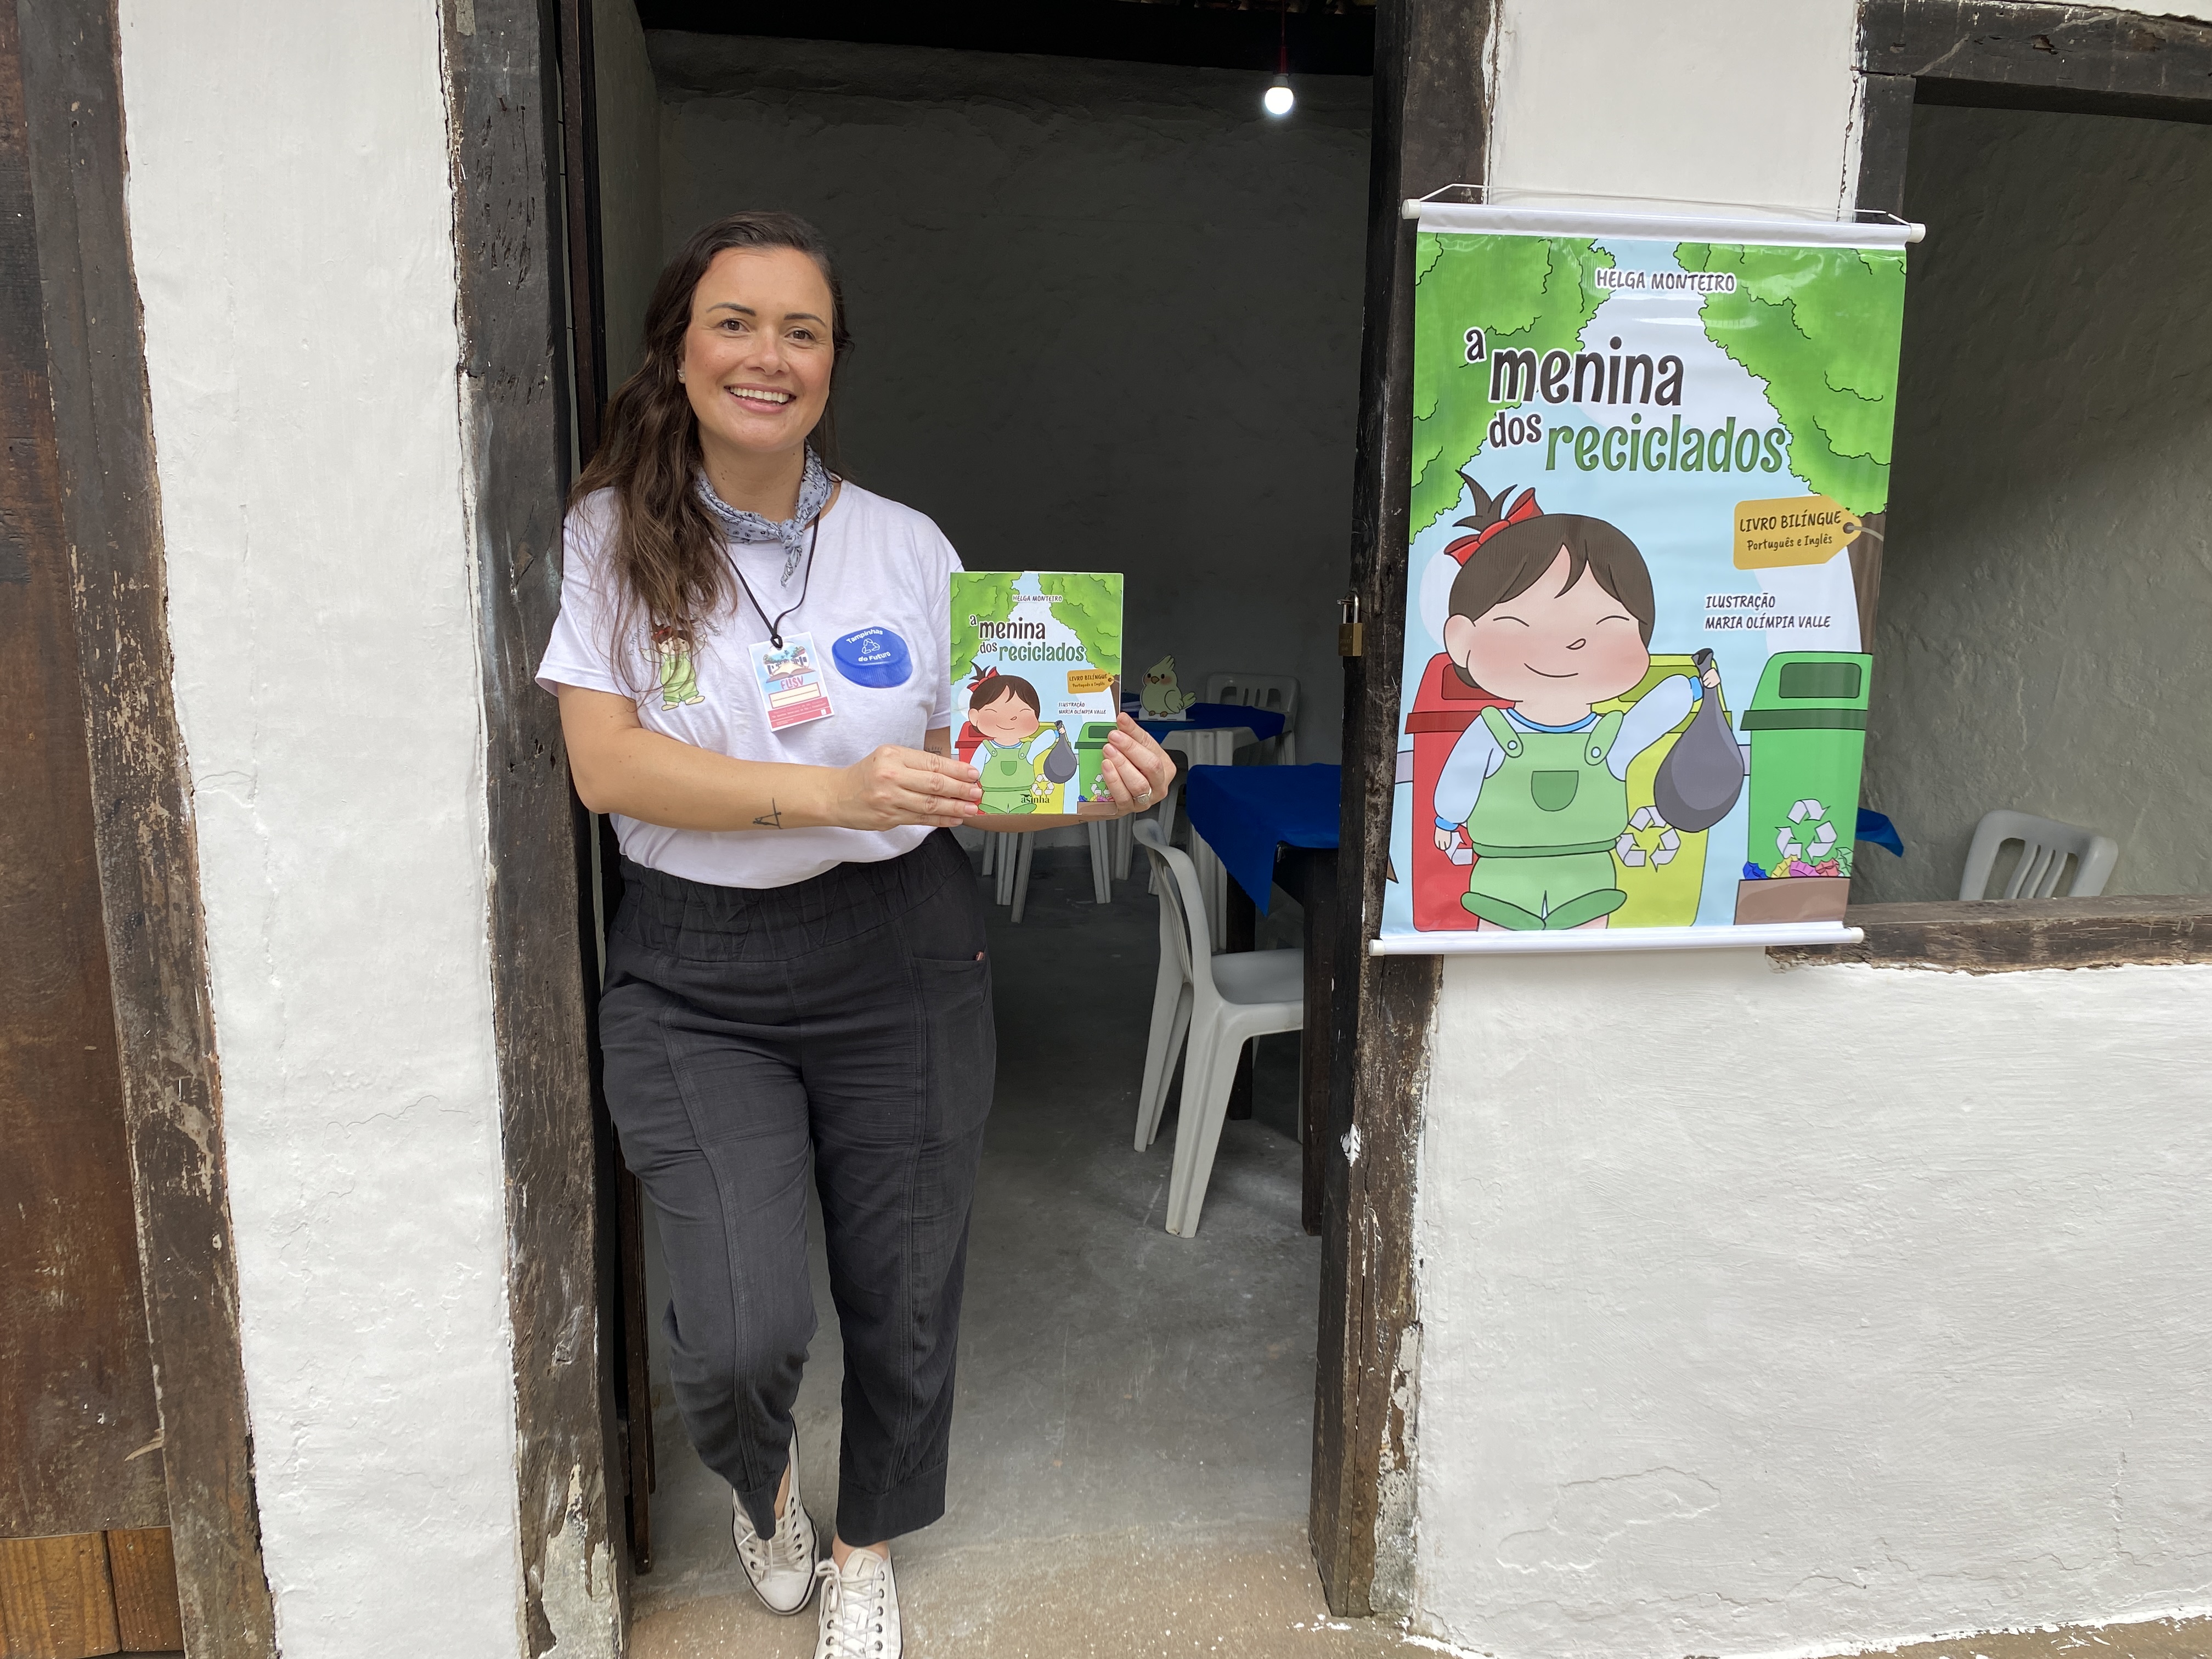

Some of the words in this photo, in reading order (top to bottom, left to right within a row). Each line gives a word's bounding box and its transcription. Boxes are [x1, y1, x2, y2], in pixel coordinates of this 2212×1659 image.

[1596, 269, 1645, 289] HELGA
[1651, 273, 1735, 292] MONTEIRO
[1466, 329, 1485, 361] a
[1489, 336, 1684, 405] menina
[1488, 412, 1542, 448] dos
[1545, 413, 1785, 472] reciclados
[1740, 516, 1777, 532] LIVRO
[1781, 509, 1842, 529] BILÍNGUE
[1747, 537, 1794, 551] Português
[1797, 539, 1802, 547] e
[1804, 533, 1833, 548] Inglês
[1705, 592, 1776, 611] ILUSTRAÇÃO
[969, 615, 977, 625] a
[979, 617, 1045, 639] menina
[1705, 616, 1743, 629] MARIA
[1746, 613, 1795, 629] OLÍMPIA
[1798, 616, 1831, 628] VALLE
[846, 629, 883, 644] Tampinhas
[869, 651, 891, 661] Futuro
[980, 642, 997, 653] dos
[999, 641, 1085, 661] reciclados
